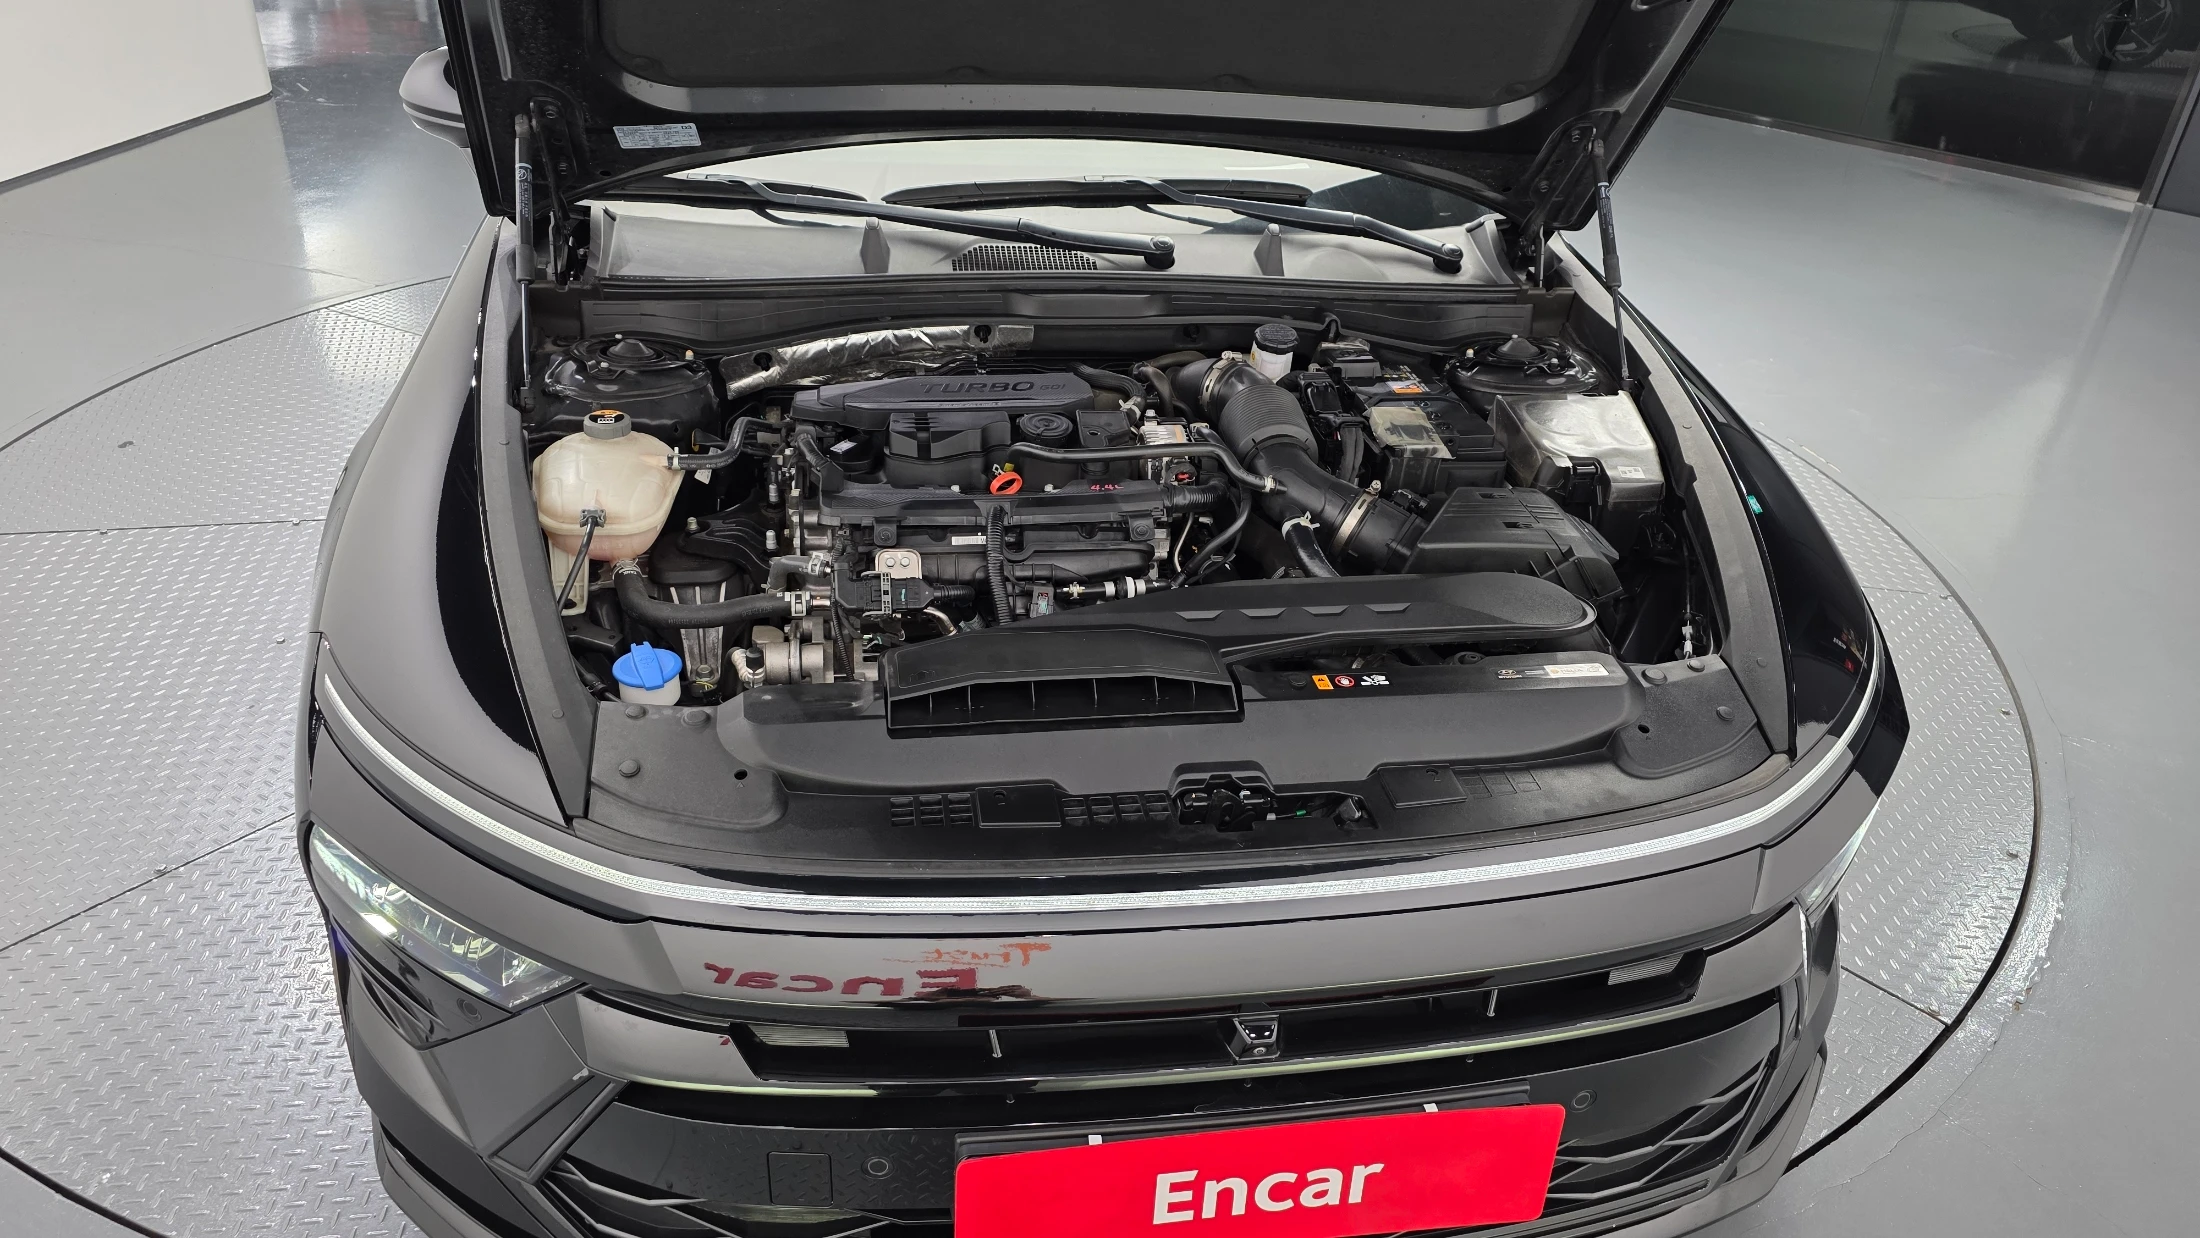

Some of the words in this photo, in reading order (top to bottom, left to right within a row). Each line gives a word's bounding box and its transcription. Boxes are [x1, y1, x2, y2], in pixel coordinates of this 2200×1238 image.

[920, 381, 1035, 394] TURBO
[1039, 383, 1066, 391] GDI
[1152, 1163, 1385, 1225] Encar
